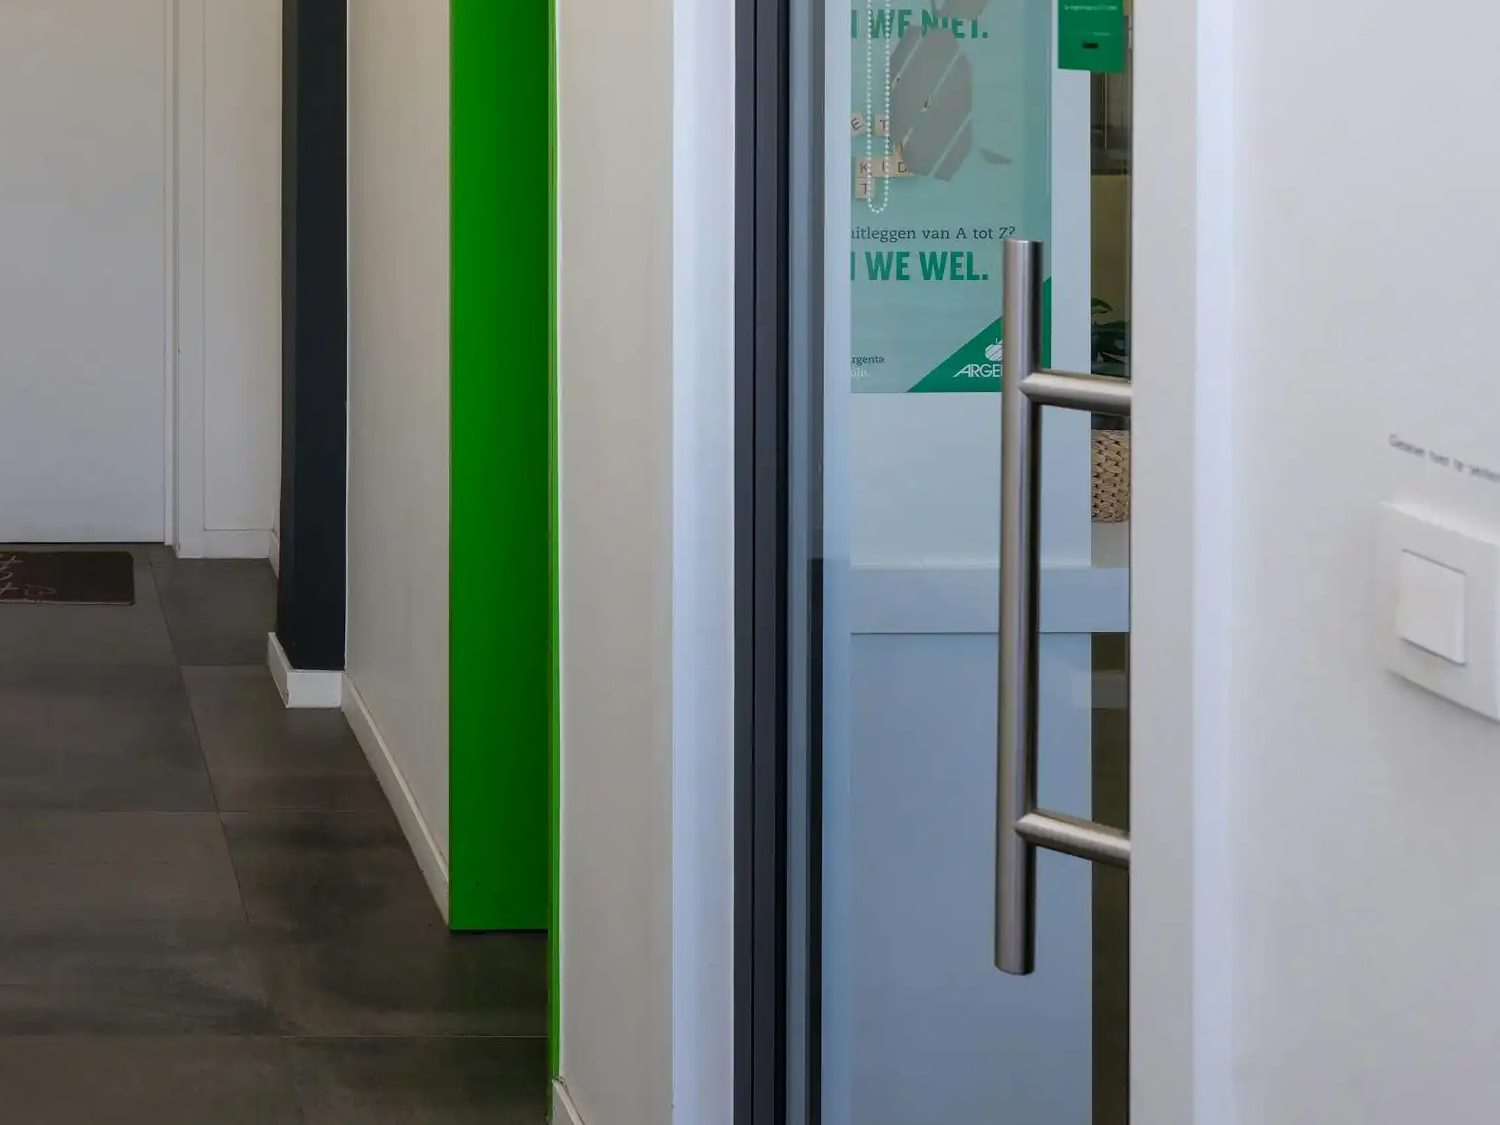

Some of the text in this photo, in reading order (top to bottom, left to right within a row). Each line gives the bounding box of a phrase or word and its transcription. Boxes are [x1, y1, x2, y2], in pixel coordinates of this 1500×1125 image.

[922, 229, 949, 239] van
[955, 227, 967, 239] A
[973, 228, 993, 239] tot
[999, 226, 1015, 239] Z?
[865, 251, 910, 281] WE
[919, 251, 988, 281] WEL.
